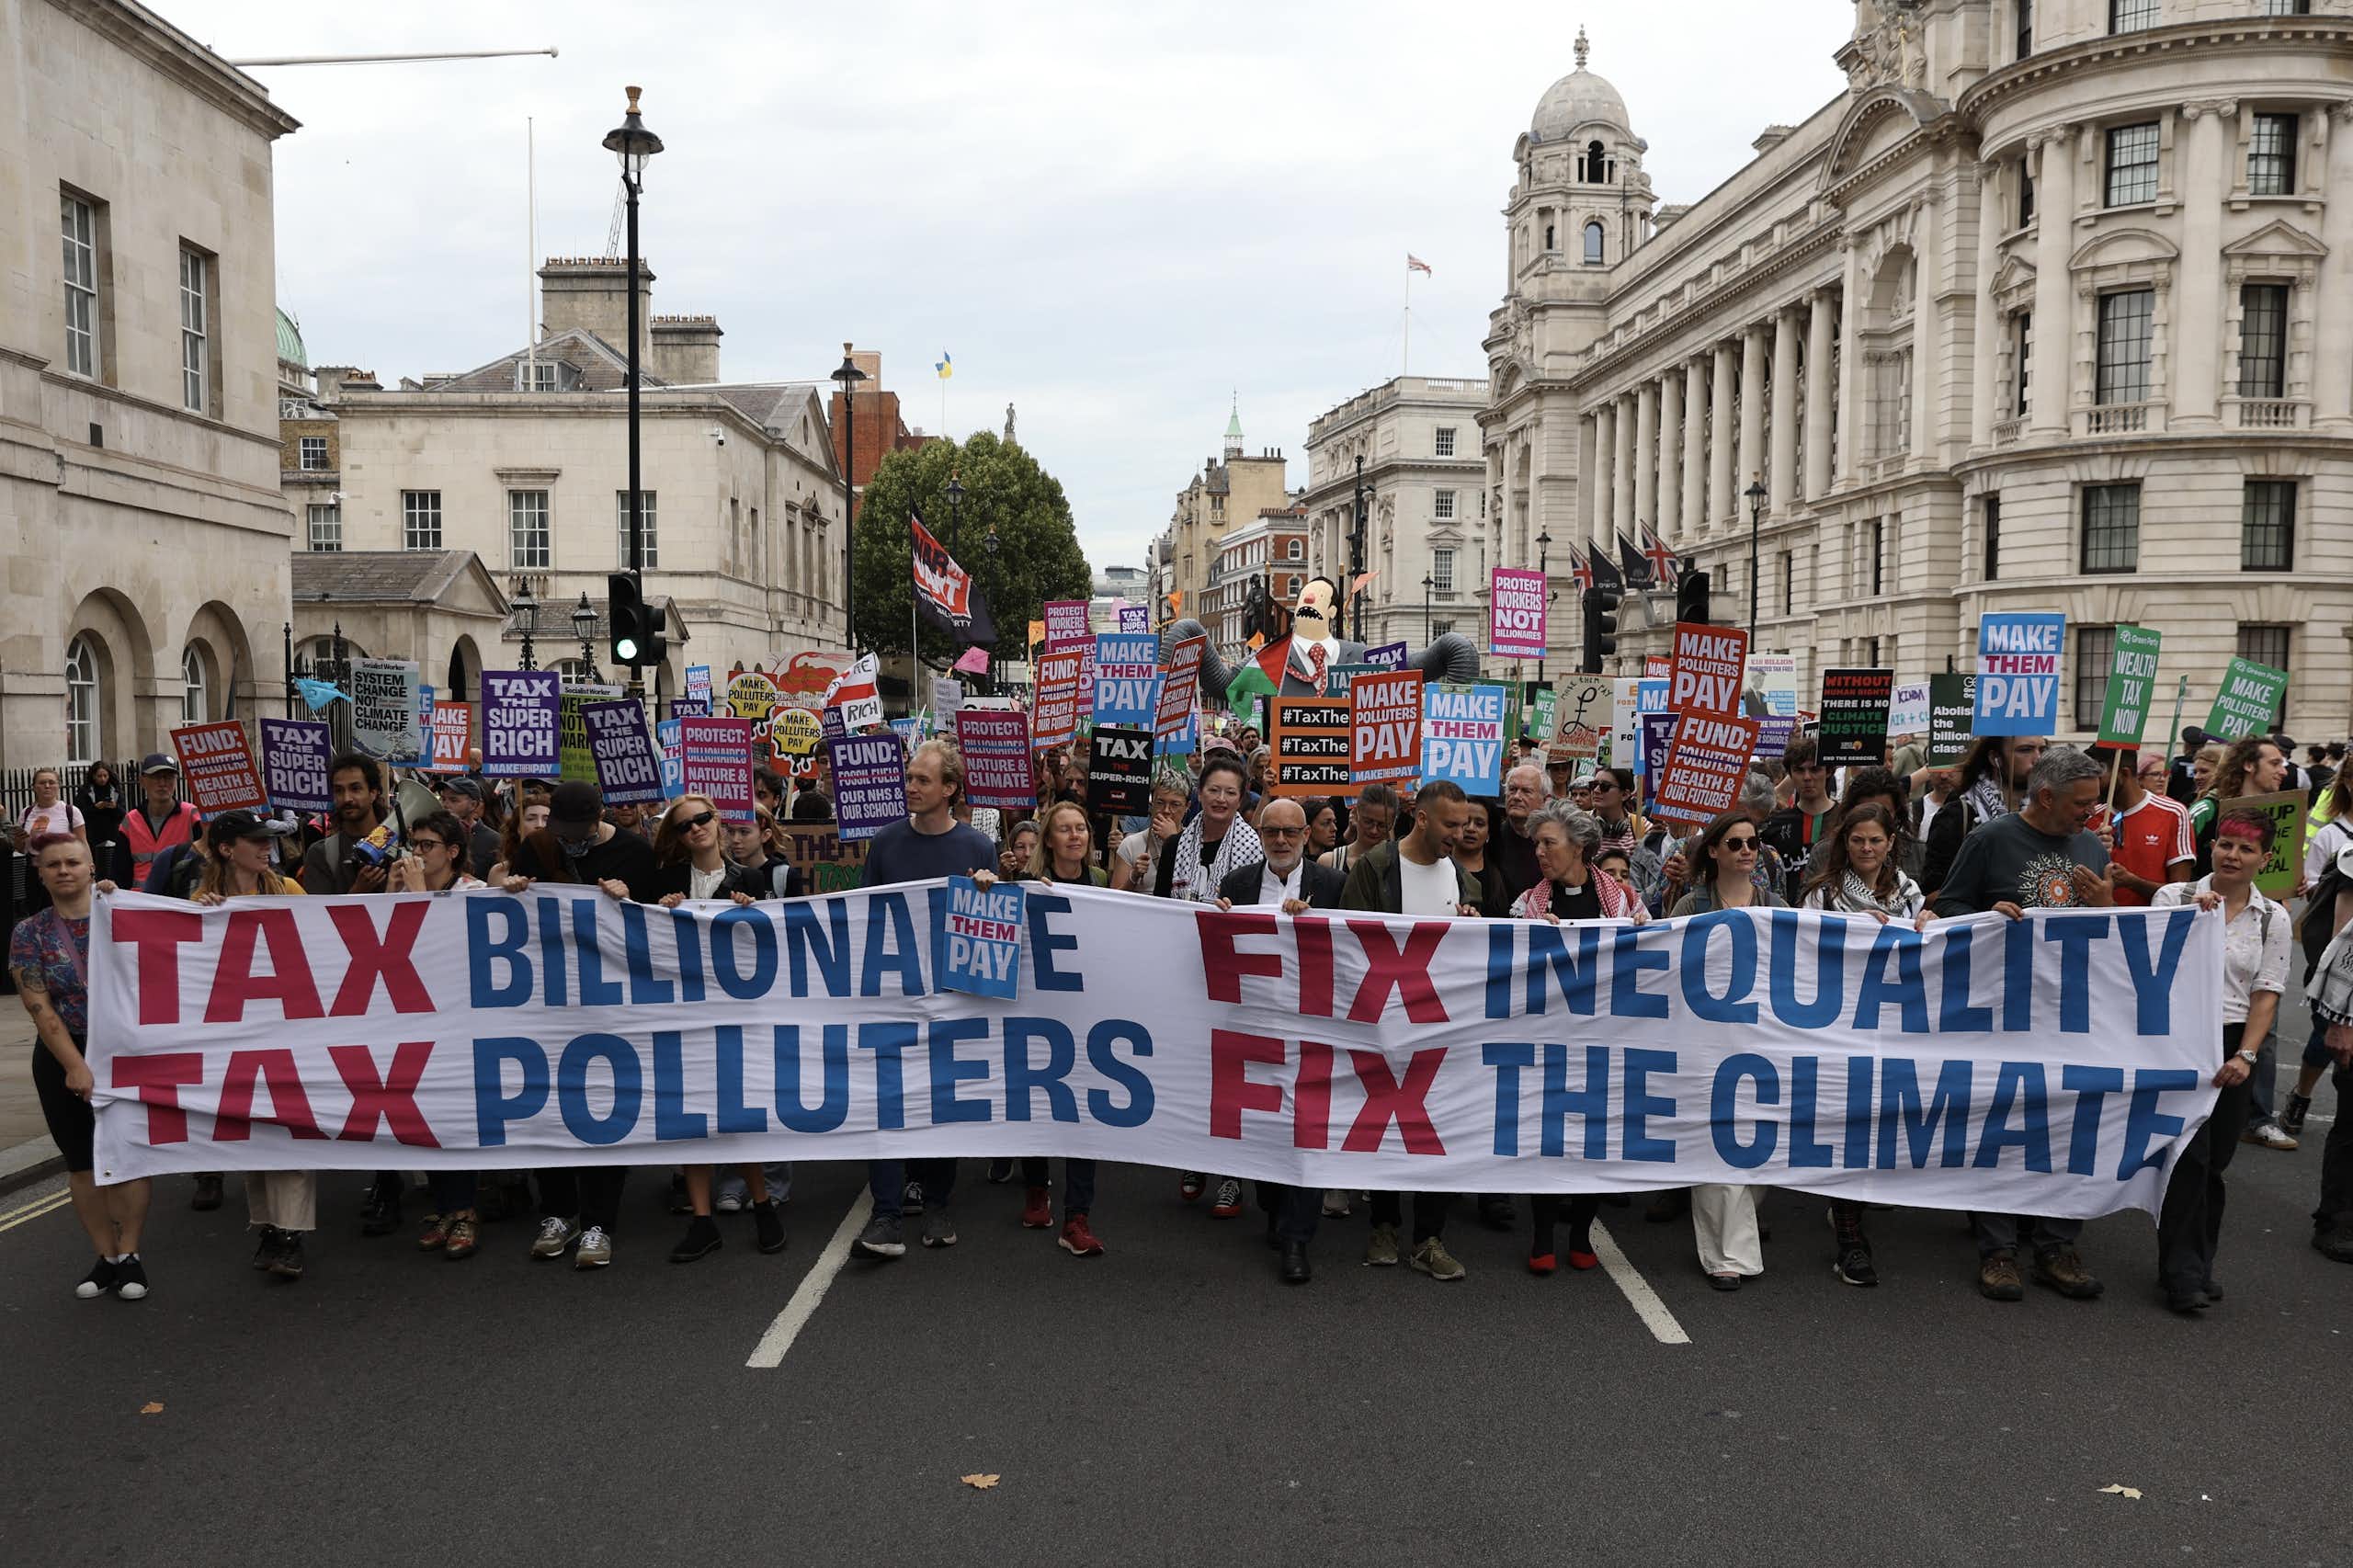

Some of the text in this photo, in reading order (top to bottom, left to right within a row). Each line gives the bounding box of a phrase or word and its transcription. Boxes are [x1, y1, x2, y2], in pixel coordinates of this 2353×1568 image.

[1496, 576, 1541, 592] PROTECT
[1496, 590, 1541, 611] WORKERS
[1048, 606, 1085, 617] PROTECT
[1495, 608, 1541, 631] NOT
[1048, 617, 1085, 630] WORKERS
[1122, 622, 1146, 631] SUPER
[1495, 629, 1541, 640] BILLIONAIRES
[1987, 625, 2058, 651] MAKE
[1101, 642, 1153, 663] MAKE
[1171, 643, 1202, 669] FUND:
[1679, 632, 1741, 662] MAKE
[1041, 659, 1078, 682] FUND:
[1103, 665, 1152, 678] THEM
[1678, 657, 1739, 676] POLLUTERS
[1985, 655, 2054, 673] THEM
[2116, 651, 2156, 677] WEALTH
[355, 672, 404, 686] SYSTEM
[688, 670, 709, 682] MAKE
[741, 679, 765, 689] MAKE
[1825, 676, 1891, 686] WITHOUT
[355, 683, 407, 698] CHANGE
[489, 679, 551, 697] TAX
[689, 682, 710, 690] THEM
[729, 689, 776, 701] POLLUTERS
[1097, 679, 1152, 710] PAY
[1357, 680, 1417, 710] MAKE
[1674, 671, 1737, 711] PAY
[2121, 679, 2143, 706] TAX
[2230, 676, 2274, 704] MAKE
[355, 695, 378, 707] NOT
[499, 698, 540, 707] THE
[1431, 693, 1497, 720] MAKE
[1823, 699, 1889, 708] THERE IS NO
[1980, 677, 2053, 718] PAY
[355, 707, 409, 721] CLIMATE
[675, 703, 705, 715] TAX
[744, 702, 758, 712] PAY
[847, 701, 878, 722] RICH
[1039, 701, 1067, 718] HEALTH
[1357, 707, 1416, 724] POLLUTERS
[1827, 711, 1882, 721] CLIMATE
[2217, 695, 2271, 721] POLLUTERS
[355, 718, 407, 733] CHANGE
[489, 709, 552, 728] SUPER
[588, 707, 640, 728] TAX
[787, 715, 810, 725] MAKE
[1037, 718, 1051, 733] OUR
[1933, 719, 1953, 728] the
[2112, 708, 2140, 734] NOW
[2220, 714, 2254, 735] PAY
[267, 725, 324, 745] TAX
[600, 726, 633, 737] THE
[687, 728, 746, 744] PROTECT:
[774, 725, 821, 737] POLLUTERS
[963, 720, 1024, 735] PROTECT:
[1431, 721, 1496, 739] THEM
[1681, 717, 1752, 751] FUND:
[1821, 723, 1887, 734] JUSTICE
[178, 729, 243, 756] FUND:
[278, 743, 313, 754] THE
[489, 730, 553, 756] RICH
[596, 735, 647, 759] SUPER
[788, 737, 803, 747] PAY
[1097, 737, 1148, 760] TAX
[1356, 722, 1415, 762] PAY
[269, 750, 326, 772] SUPER
[835, 742, 898, 767] FUND:
[1428, 740, 1496, 778] PAY
[489, 764, 552, 774] MAKE PAY
[601, 757, 654, 787] RICH
[688, 767, 747, 781] NATURE &
[967, 758, 1028, 772] NATURE &
[1111, 762, 1130, 771] THE
[1356, 767, 1414, 781] MAKE PAY
[195, 772, 255, 792] HEALTH &
[271, 767, 328, 796] RICH
[969, 772, 1029, 789] CLIMATE
[1090, 771, 1149, 784] SUPER-RICH
[1669, 767, 1736, 793] HEALTH &
[199, 787, 259, 807] OUR FUTURES
[608, 789, 657, 802] MAKE PAY
[688, 782, 748, 800] CLIMATE
[840, 787, 904, 803] OUR NHS &
[1665, 784, 1731, 810] OUR FUTURES
[273, 796, 329, 810] MAKE PAY
[973, 796, 1029, 806] MAKE PAY
[730, 810, 746, 820] PAY
[842, 801, 905, 820] OUR SCHOOLS
[1659, 805, 1691, 820] MAKE
[846, 827, 875, 838] MAKE
[953, 888, 1017, 921] MAKE
[952, 915, 1015, 941] THEM
[111, 888, 1085, 1025] TAX BILLIONAIE
[949, 936, 1015, 981] PAY
[1196, 908, 2197, 1036] FIX INEQUALITY
[111, 1017, 1155, 1148] TAX POLLUTERS
[1211, 1028, 2199, 1181] FIX THE CLIMATE
